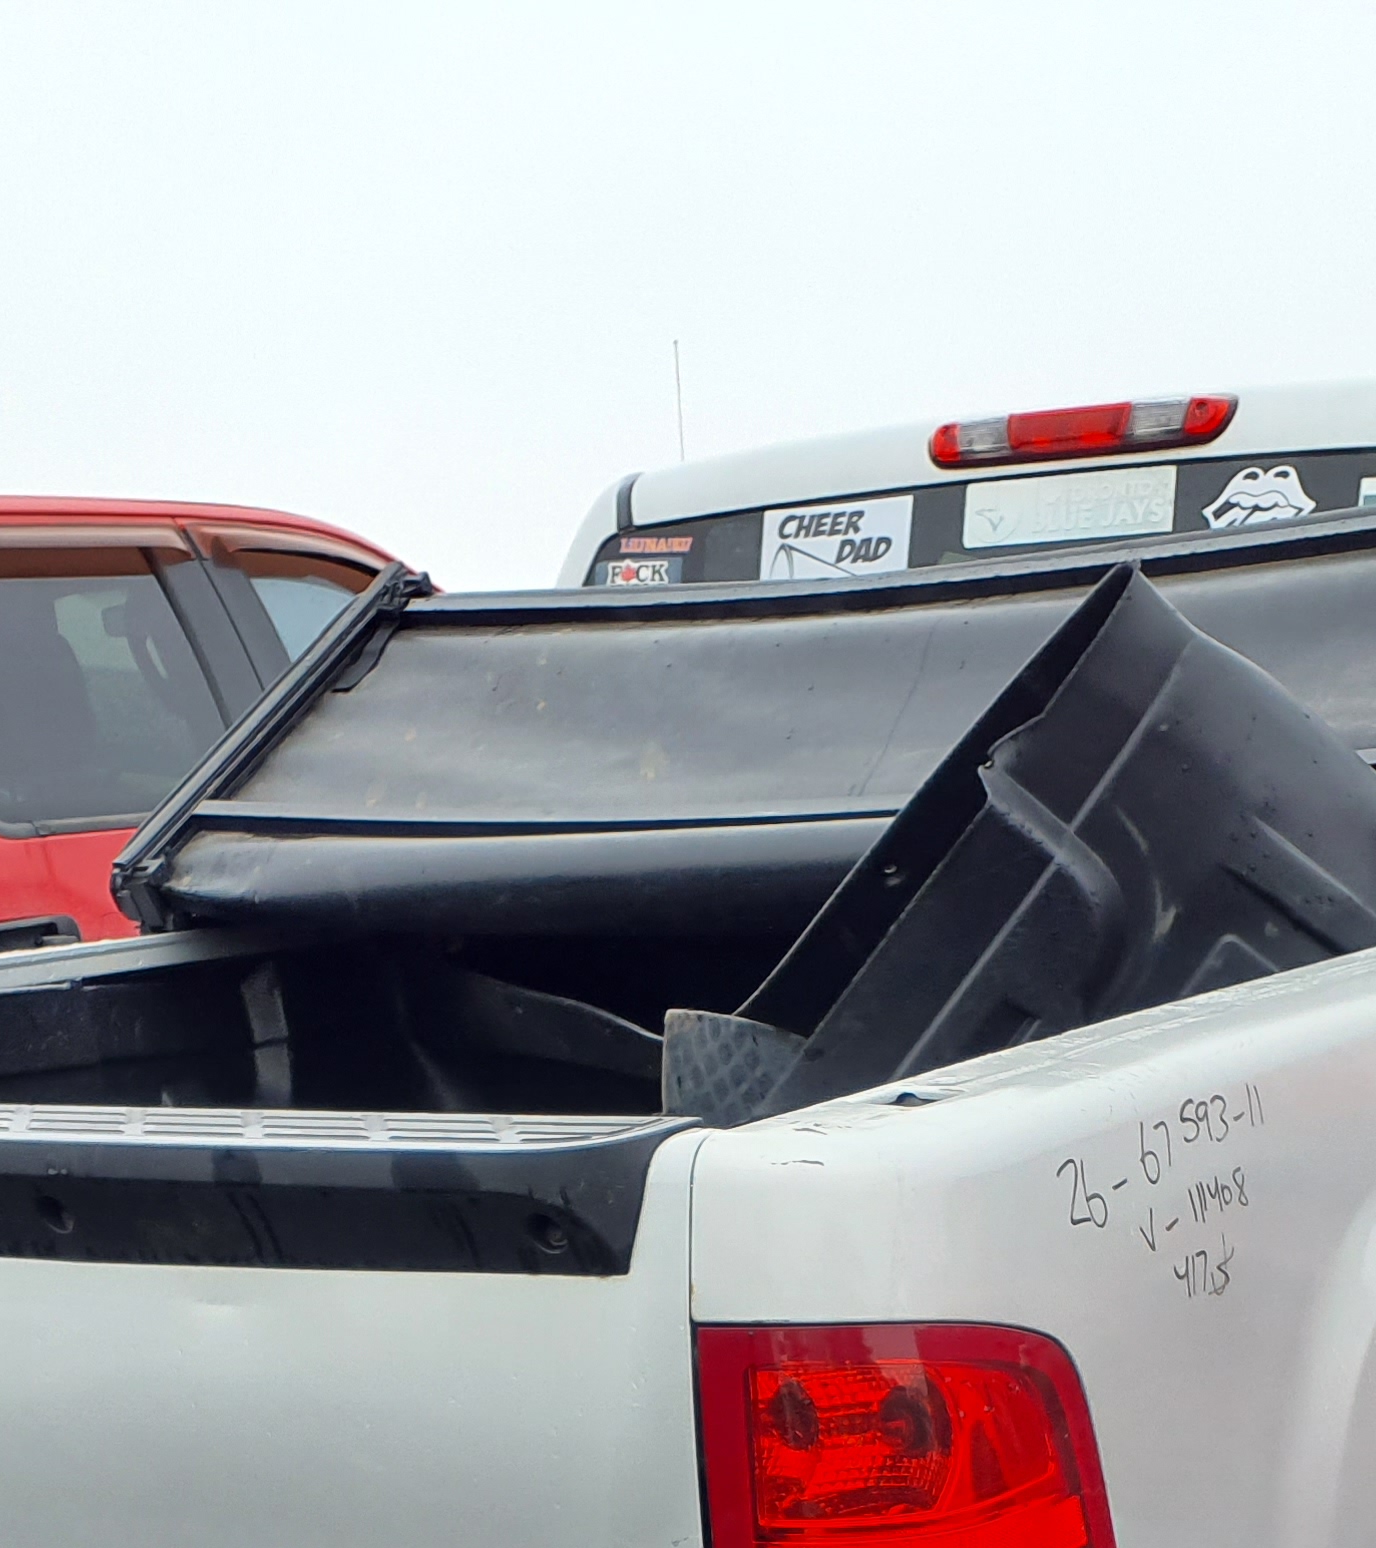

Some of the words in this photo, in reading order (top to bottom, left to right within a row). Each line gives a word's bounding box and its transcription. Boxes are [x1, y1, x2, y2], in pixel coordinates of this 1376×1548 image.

[778, 510, 865, 539] CHEER
[1099, 498, 1166, 528] JAYS
[835, 537, 892, 564] DAD
[610, 562, 665, 584] FCK
